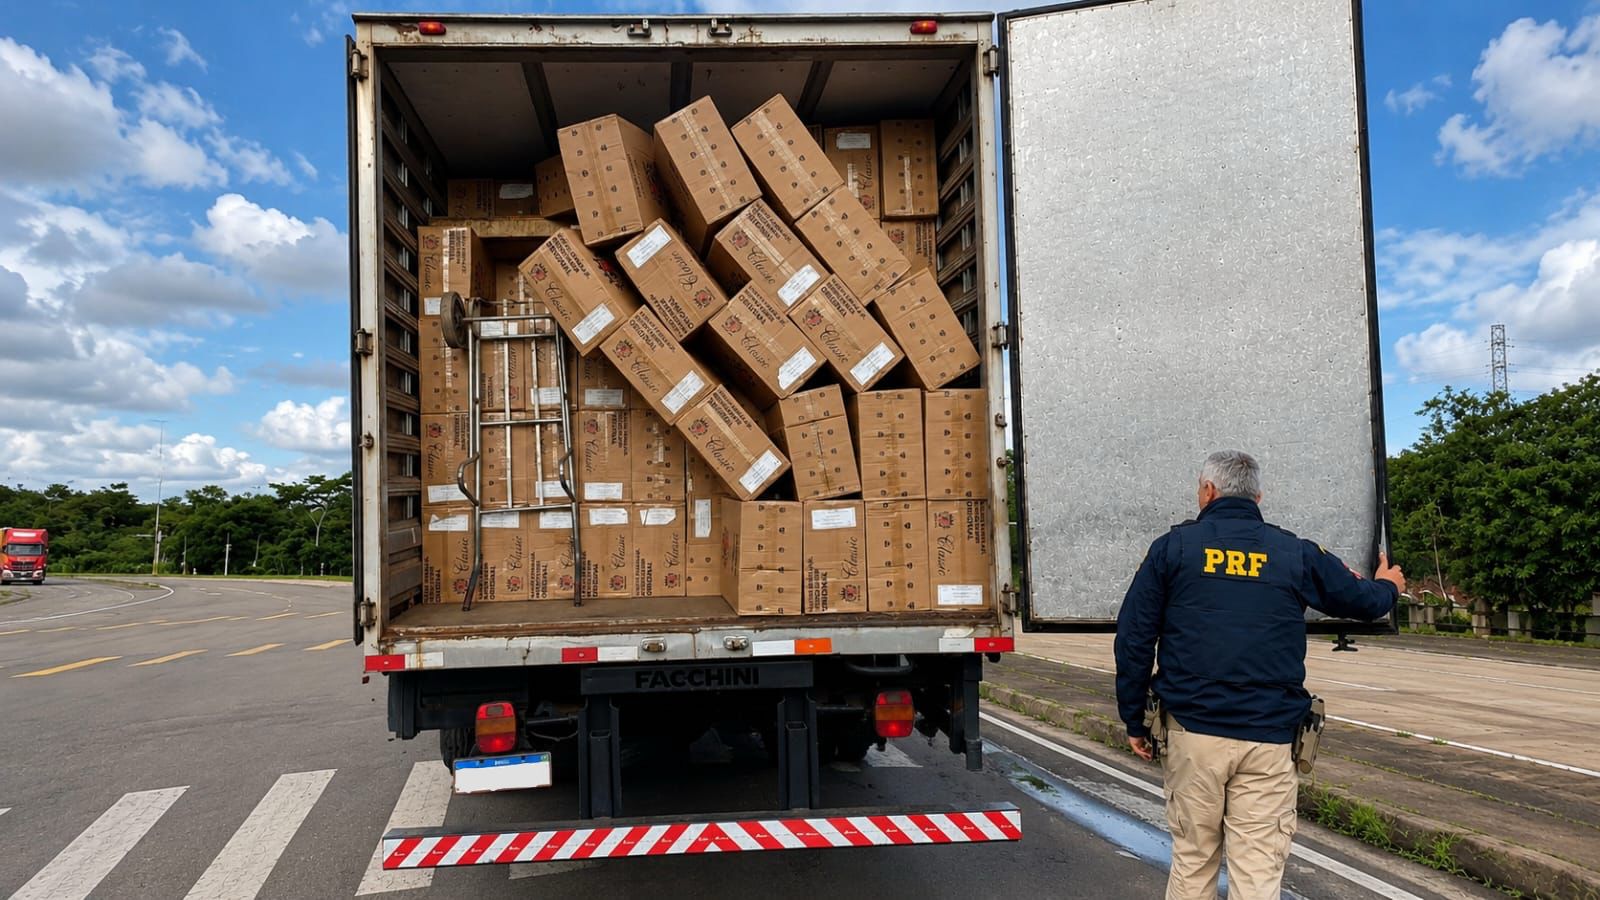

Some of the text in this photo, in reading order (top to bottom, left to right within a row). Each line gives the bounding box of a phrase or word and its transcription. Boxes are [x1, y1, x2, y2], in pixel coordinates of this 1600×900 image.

[705, 436, 735, 473] Classic
[453, 537, 470, 575] Classic
[508, 535, 523, 571] Classic
[664, 532, 679, 569] Classic
[937, 534, 956, 576] Classic
[1204, 548, 1267, 577] PRF
[635, 667, 759, 689] FACCHINI
